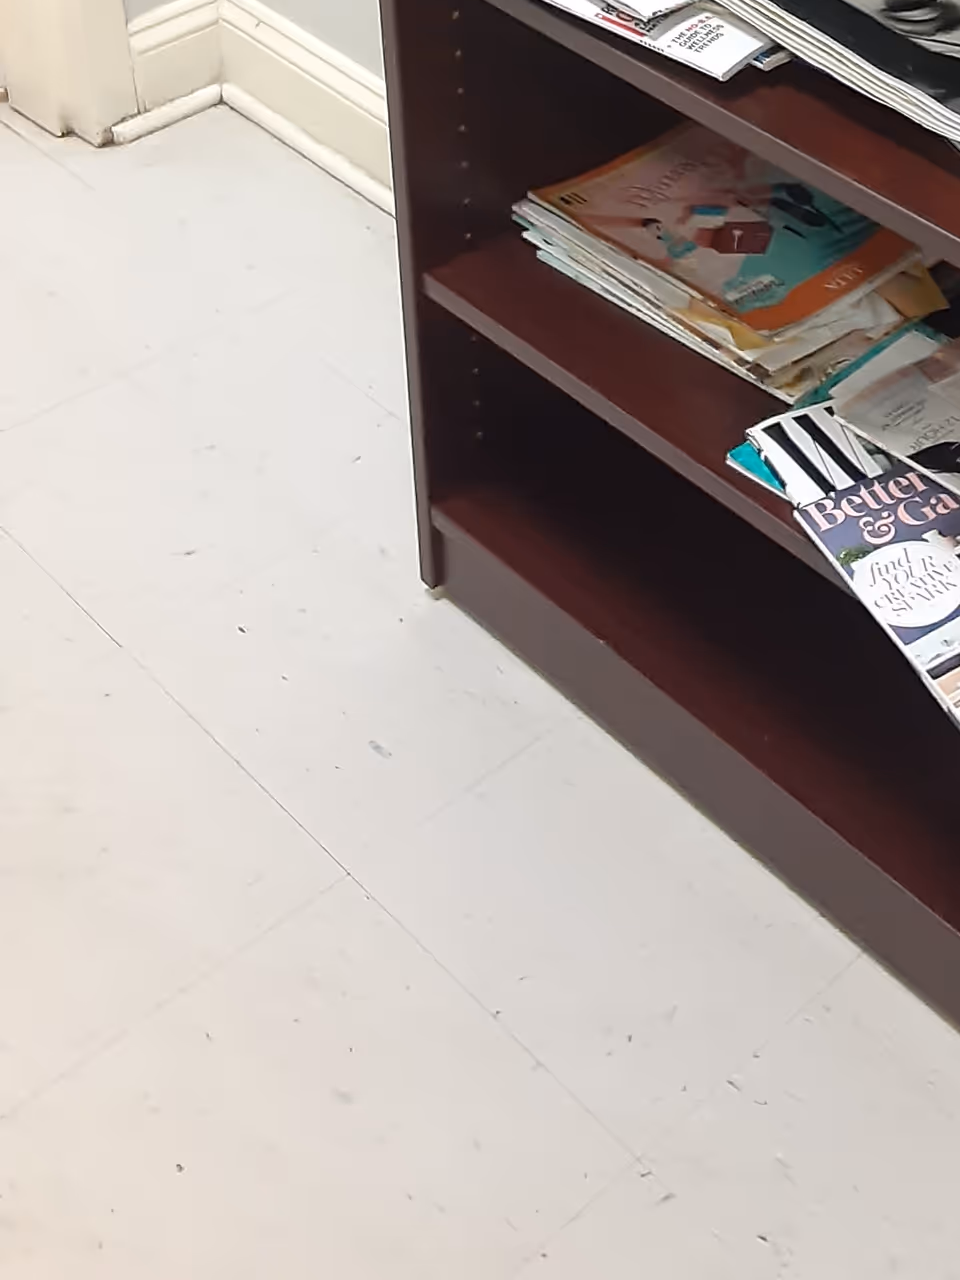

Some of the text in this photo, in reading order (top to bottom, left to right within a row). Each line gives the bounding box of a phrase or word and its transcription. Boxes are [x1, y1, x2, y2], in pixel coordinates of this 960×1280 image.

[671, 32, 687, 44] THE
[679, 23, 712, 47] GUIDE TO
[687, 24, 724, 51] WELLNESS
[694, 33, 725, 54] TRENDS
[803, 472, 929, 532] Better
[859, 511, 898, 545] &
[869, 548, 912, 587] find
[881, 555, 937, 592] YOUR
